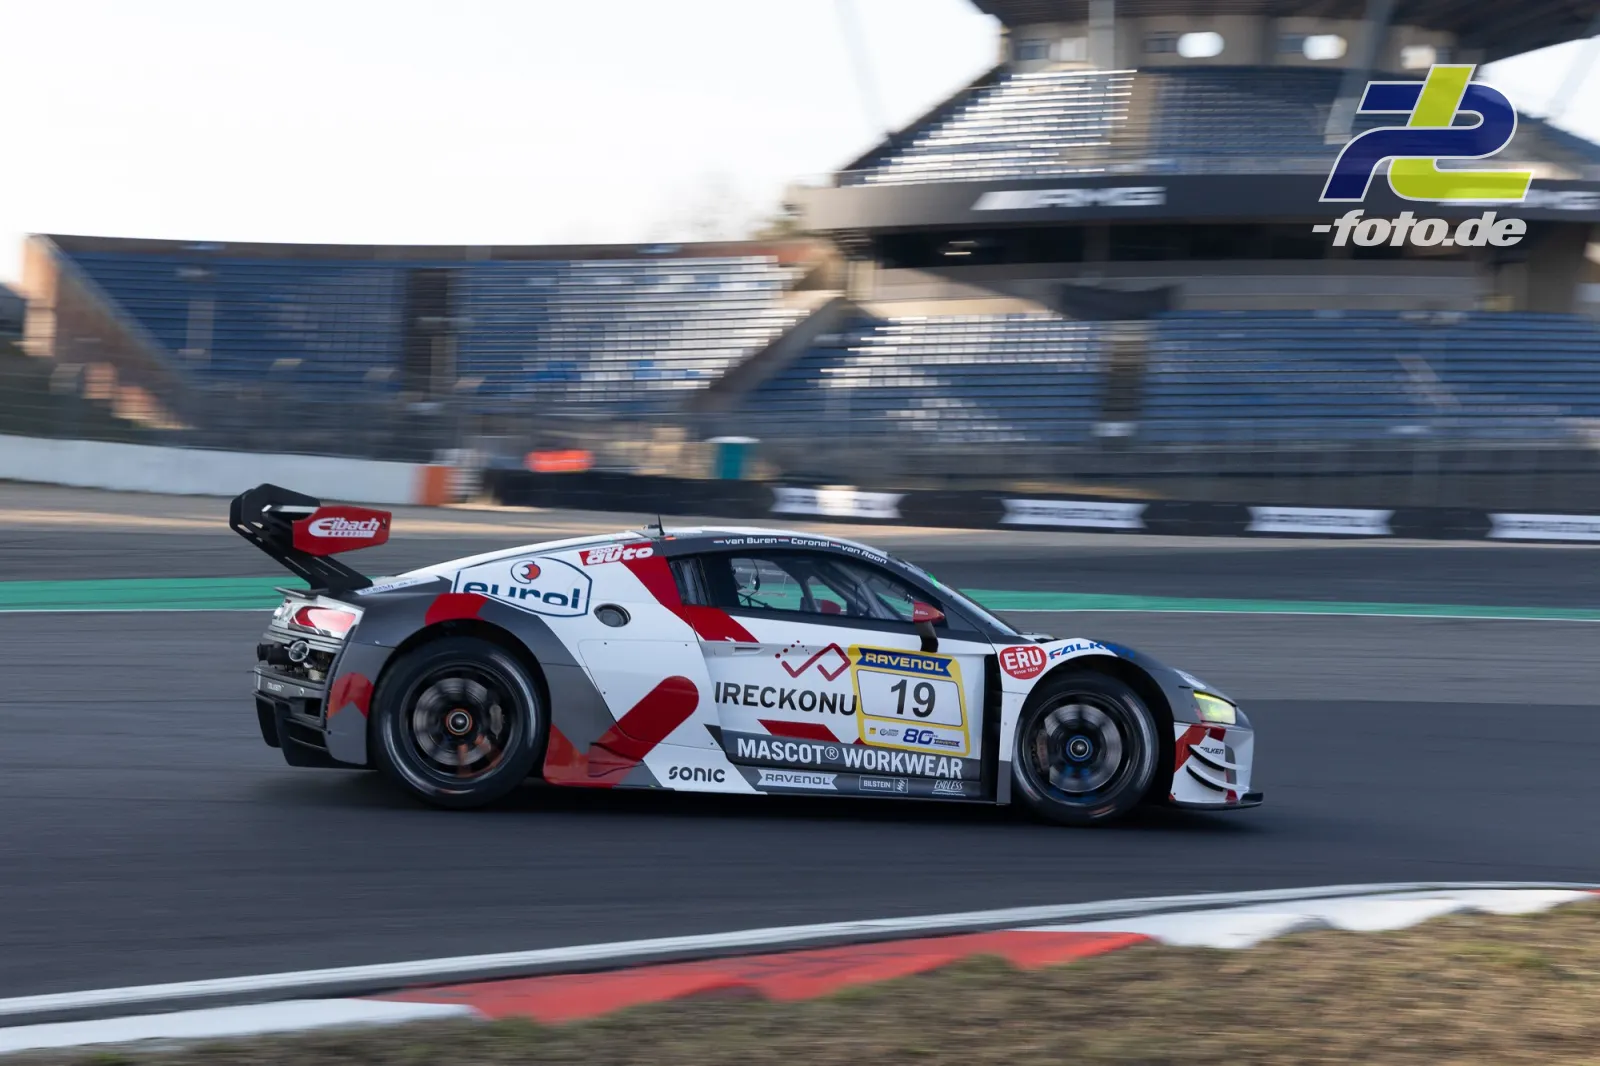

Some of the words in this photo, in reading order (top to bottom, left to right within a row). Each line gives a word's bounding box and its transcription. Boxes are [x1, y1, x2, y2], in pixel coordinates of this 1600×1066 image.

[308, 517, 380, 537] Eibach
[791, 537, 830, 548] Coronel
[586, 547, 654, 565] auto
[842, 545, 861, 555] van
[861, 551, 887, 565] Roon
[463, 581, 581, 609] eurol
[865, 652, 944, 673] RAVENOL
[1003, 649, 1043, 671] ERU
[714, 681, 857, 716] IRECKONU
[890, 678, 937, 718] 19
[902, 728, 934, 745] 80
[842, 748, 963, 780] WORKWEAR
[765, 774, 830, 785] RAVENOL
[863, 779, 891, 789] BILSTEIN
[934, 779, 964, 791] ENDLESS
